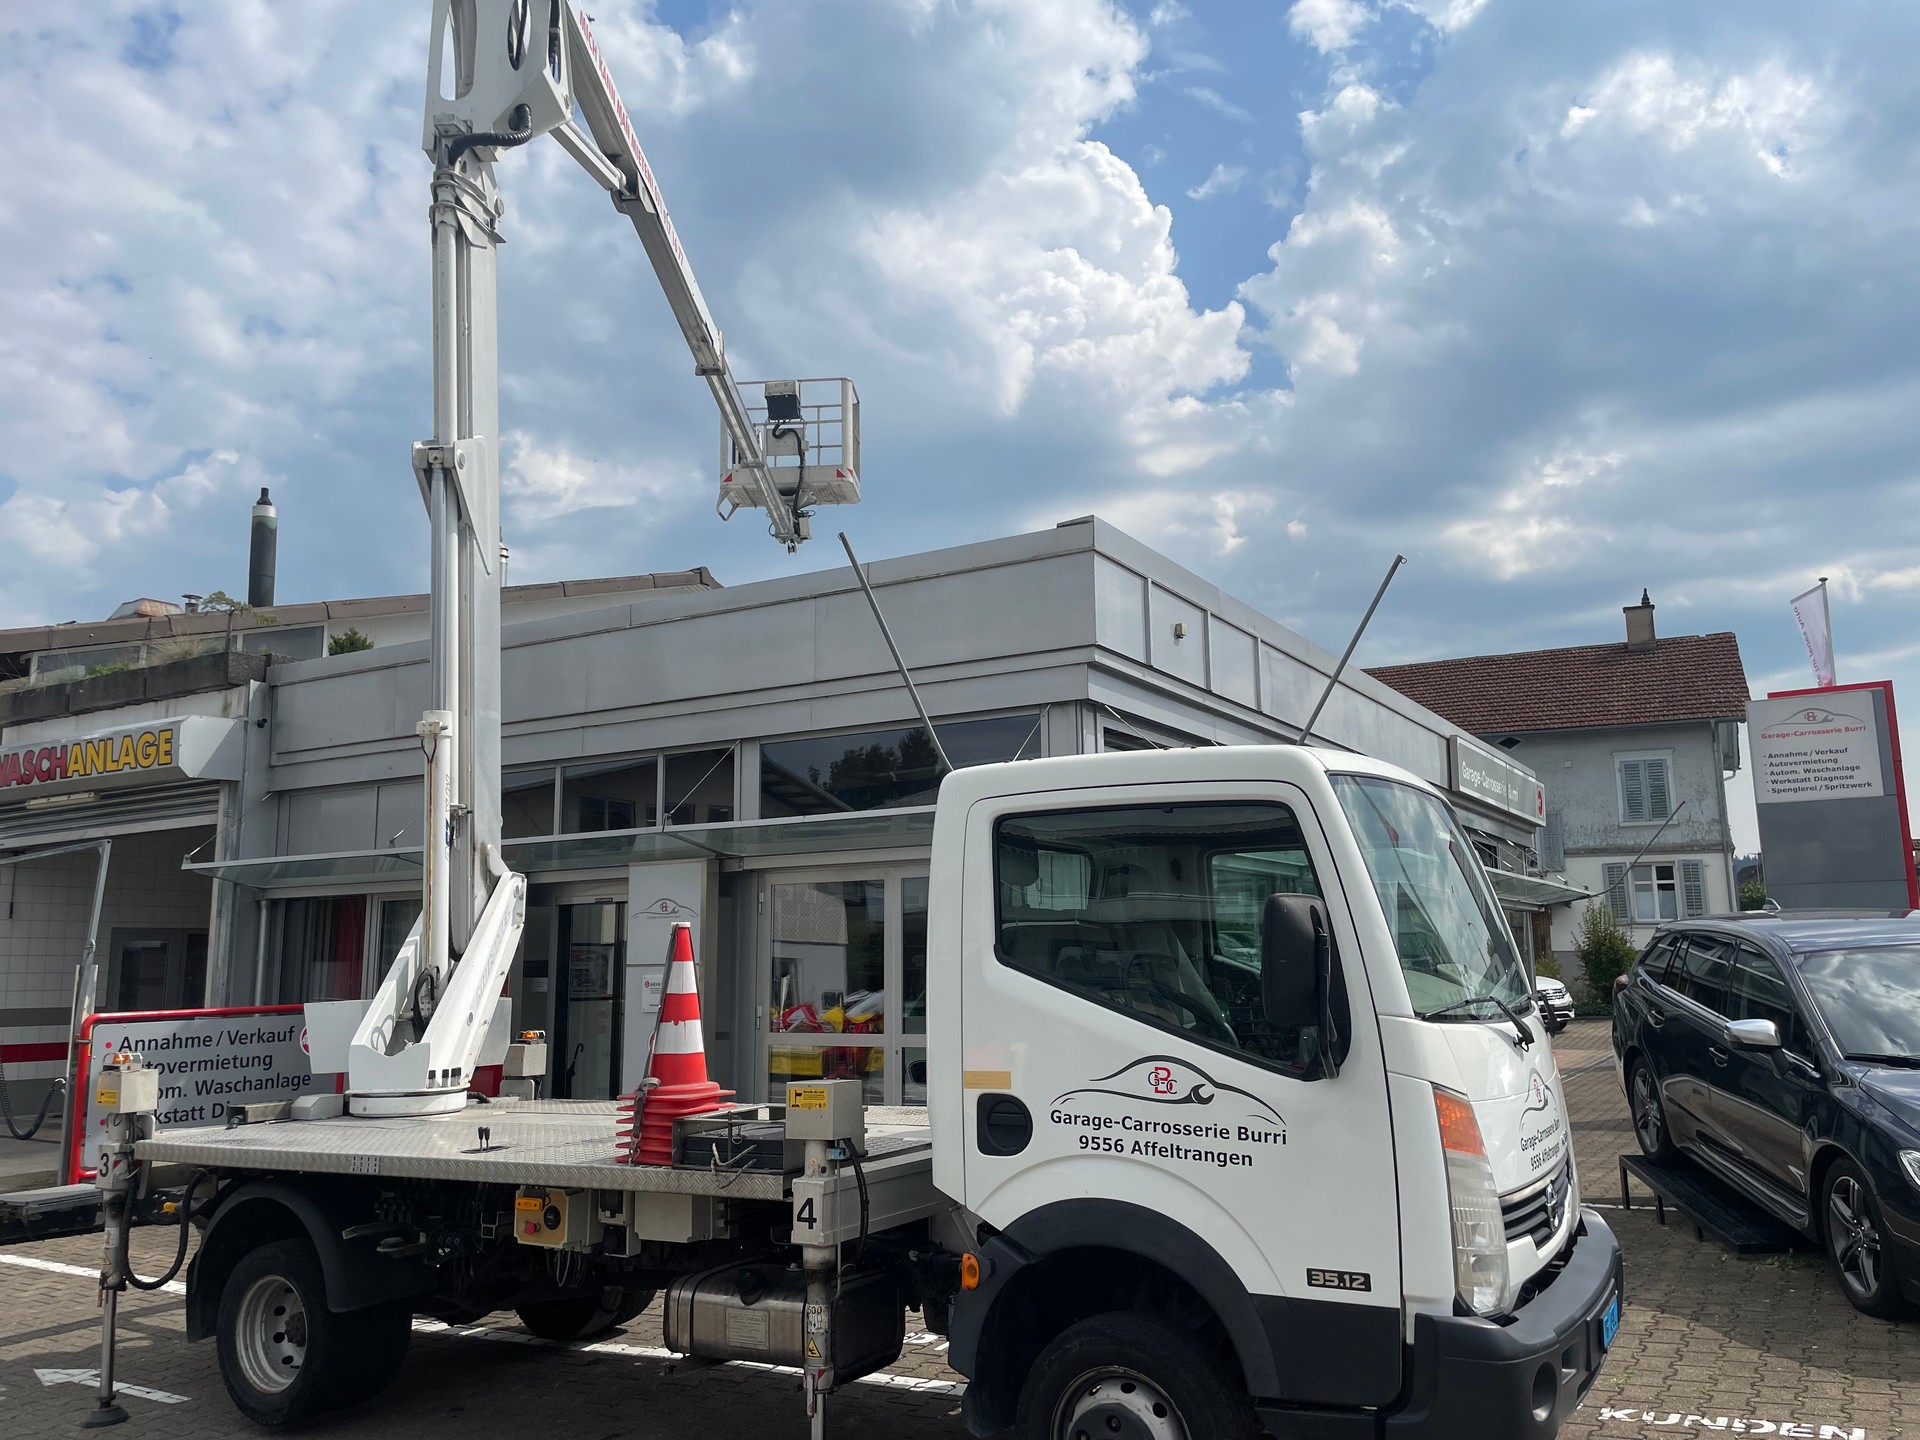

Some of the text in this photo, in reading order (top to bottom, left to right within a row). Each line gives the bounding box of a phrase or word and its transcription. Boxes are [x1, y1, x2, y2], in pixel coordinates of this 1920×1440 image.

[1761, 725, 1866, 739] Garage-Carrosserie Burri
[1768, 751, 1809, 759] Annahme
[1814, 747, 1848, 756] Verkauf
[1768, 757, 1839, 768] Autovermietung
[1769, 765, 1861, 776] Autom. Waschanlage
[1770, 774, 1854, 785] Werkstatt Diagnose
[1771, 785, 1818, 794] Spenglerei
[1824, 781, 1873, 791] Spritzwerk
[118, 1026, 295, 1052] Annahme / Verkauf
[195, 1072, 311, 1096] Waschanlage
[1050, 1109, 1287, 1145] Garage-Carrosserie Burri
[1079, 1135, 1253, 1168] 9556 Affeltrangen
[99, 1152, 110, 1178] 3
[796, 1197, 817, 1230] 4
[1311, 1270, 1365, 1289] 35.12
[1599, 1407, 1866, 1440] KUNDEN
